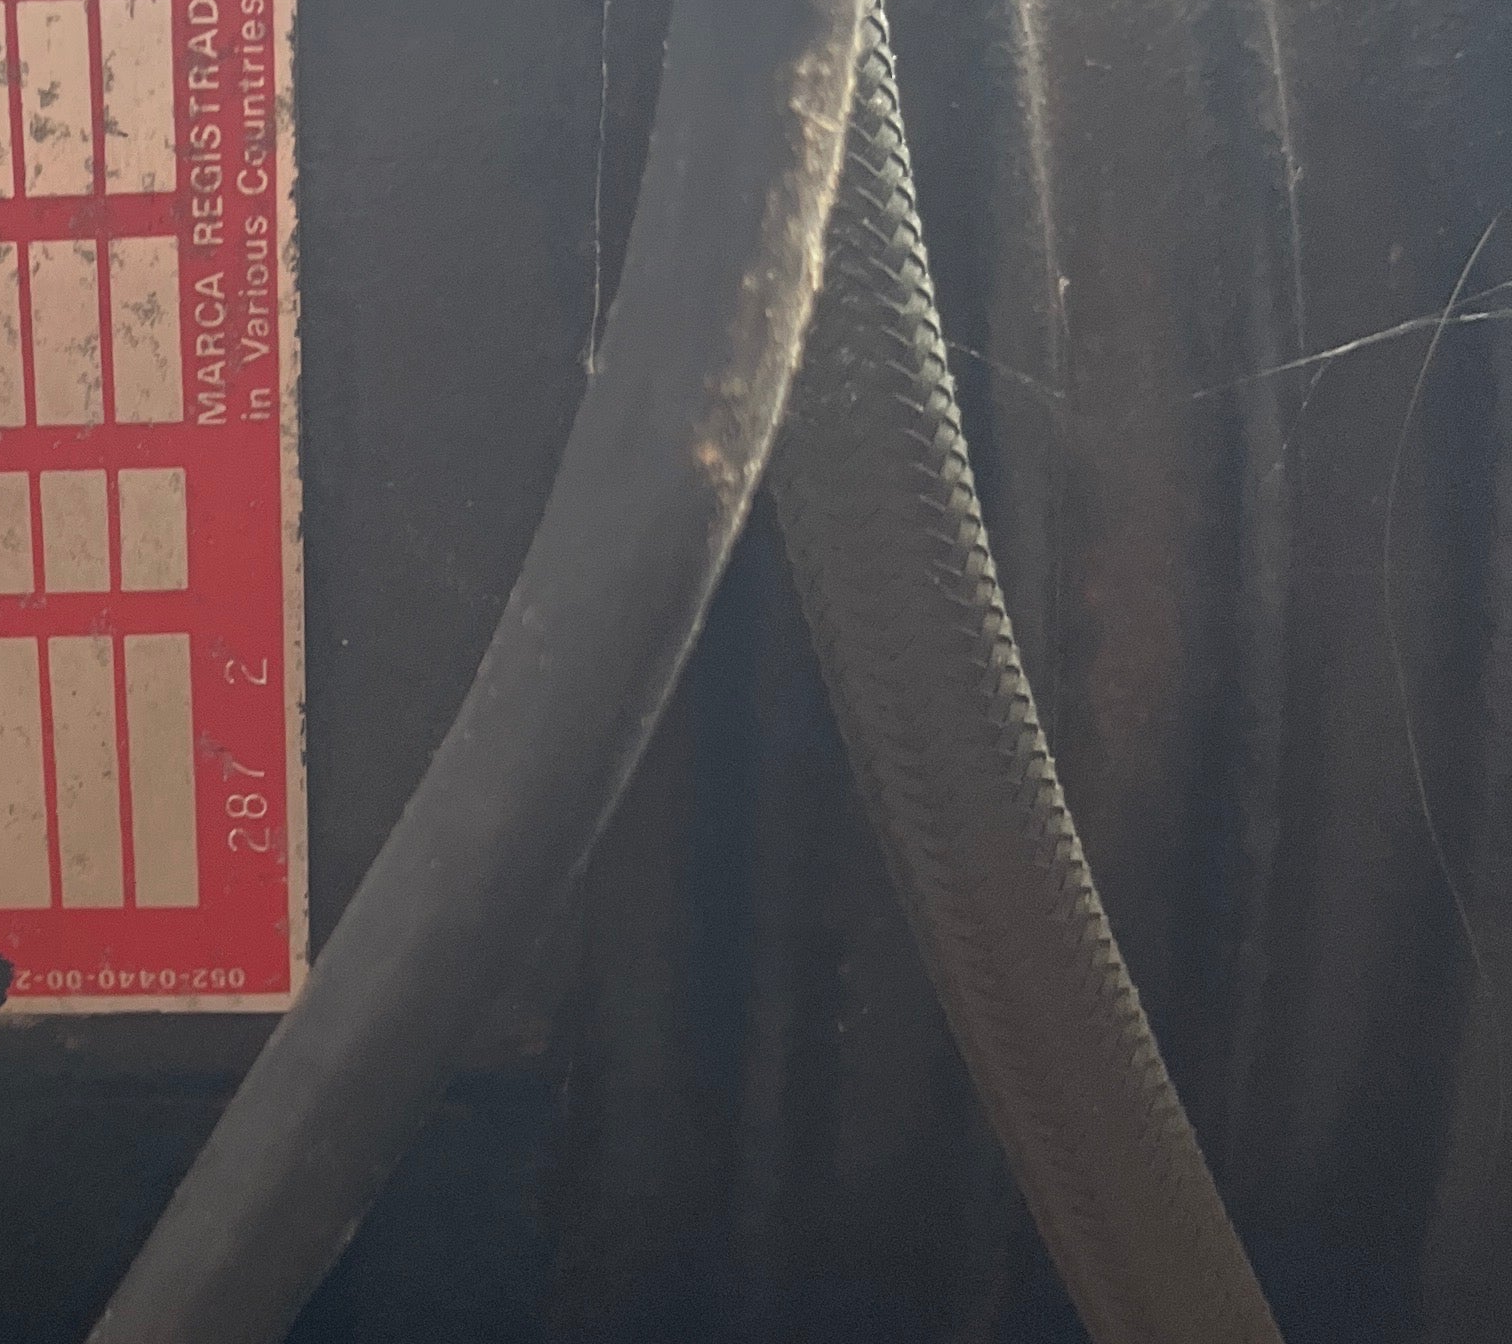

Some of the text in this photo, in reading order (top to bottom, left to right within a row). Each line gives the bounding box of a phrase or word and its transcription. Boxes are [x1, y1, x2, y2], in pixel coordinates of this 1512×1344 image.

[190, 271, 228, 424] MARCA
[239, 215, 270, 361] Various
[240, 387, 272, 420] in
[225, 657, 270, 851] 287 2
